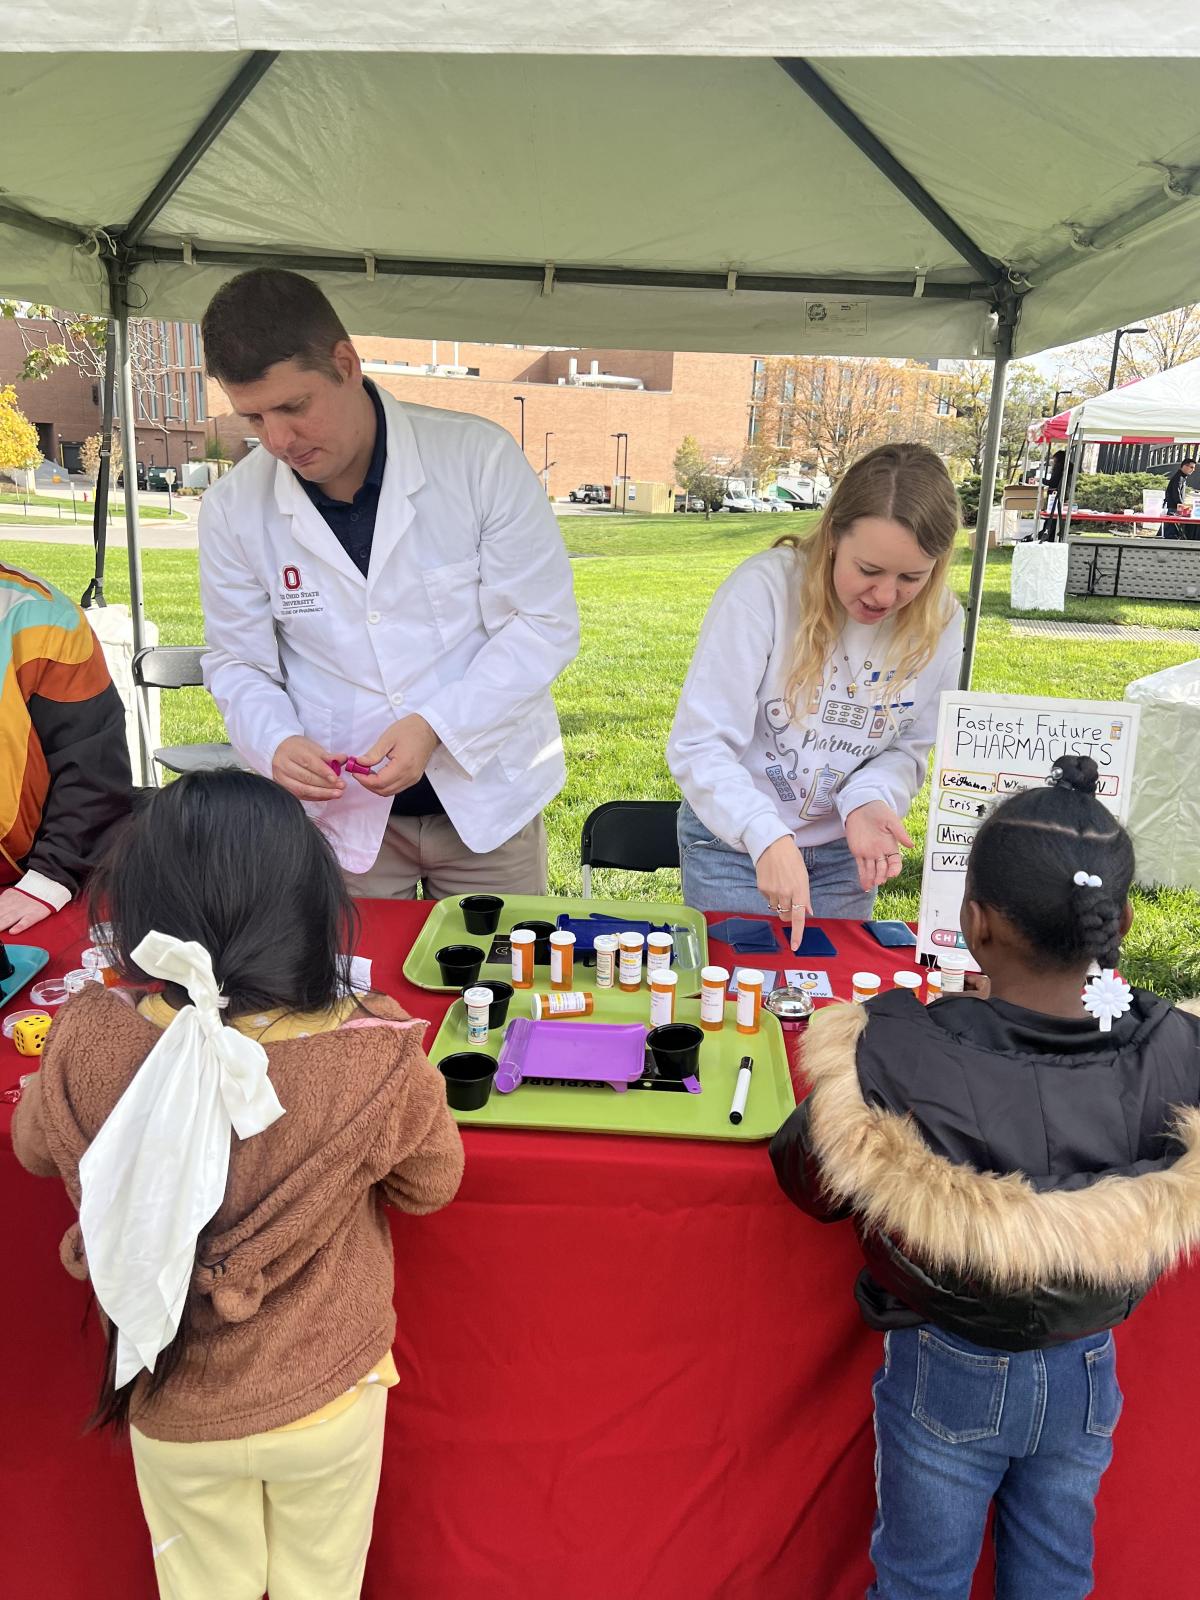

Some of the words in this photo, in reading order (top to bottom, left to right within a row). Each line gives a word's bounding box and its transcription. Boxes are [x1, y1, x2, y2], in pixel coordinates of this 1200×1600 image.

[283, 565, 302, 591] O
[956, 708, 1024, 735] Fastest
[1036, 714, 1102, 741] Future
[956, 731, 1113, 766] PHARMACISTS
[949, 798, 971, 811] Iris
[795, 972, 818, 980] 10
